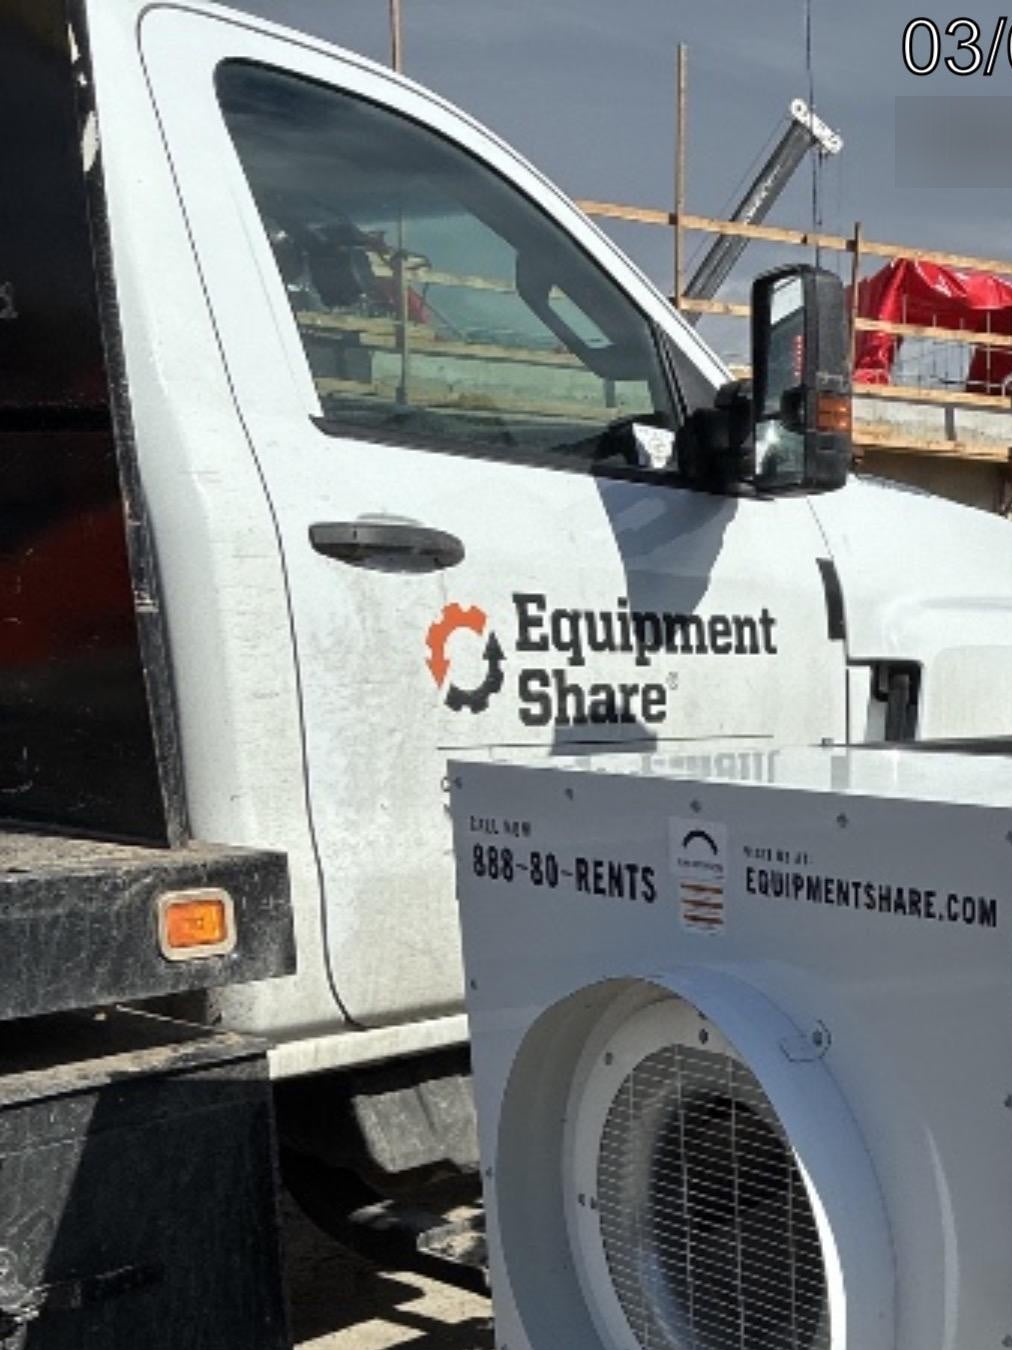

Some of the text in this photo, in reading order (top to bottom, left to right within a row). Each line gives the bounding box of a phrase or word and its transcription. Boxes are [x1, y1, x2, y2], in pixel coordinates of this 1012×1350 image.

[512, 592, 777, 666] Equipment
[473, 843, 657, 904] 888-80-RENTS
[745, 866, 998, 928] EQUIPMENTSHARE.COM
